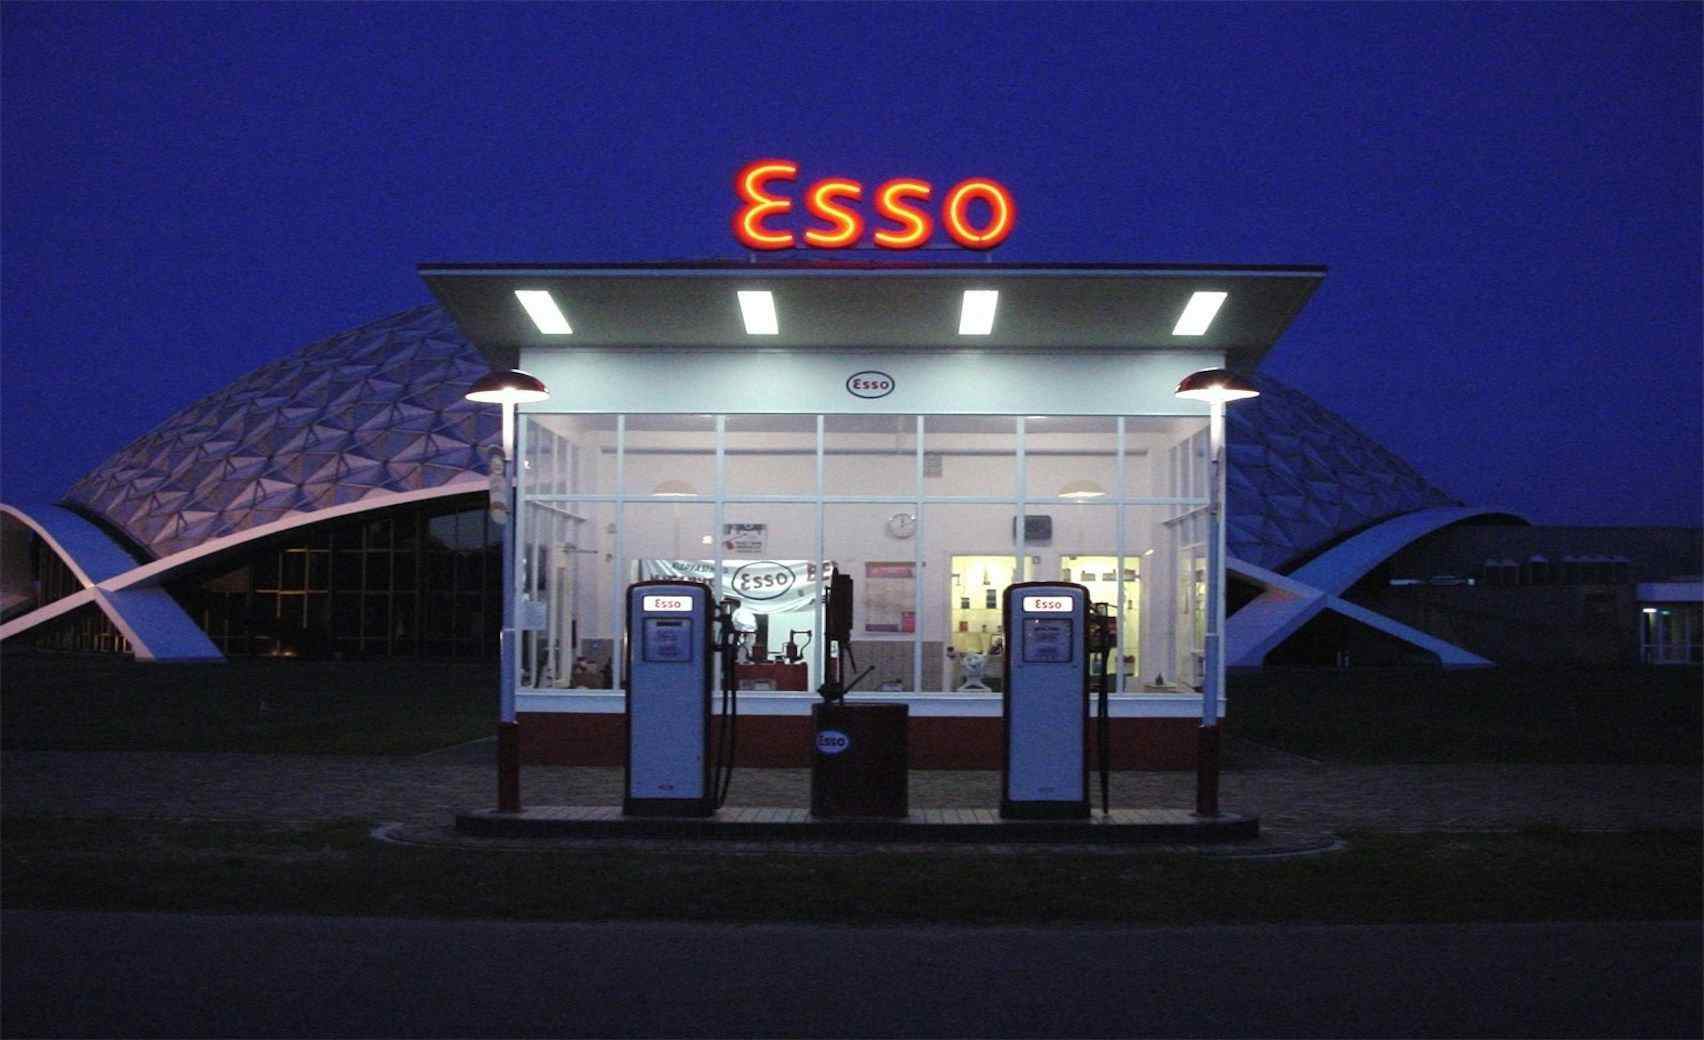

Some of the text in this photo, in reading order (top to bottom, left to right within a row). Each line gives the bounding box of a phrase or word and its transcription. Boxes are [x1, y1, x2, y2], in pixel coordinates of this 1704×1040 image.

[733, 159, 1017, 250] Esso
[853, 378, 889, 390] Esso
[740, 572, 788, 591] Esso
[655, 598, 681, 608] Esso
[1035, 599, 1062, 609] Esso
[819, 735, 846, 747] Esso
